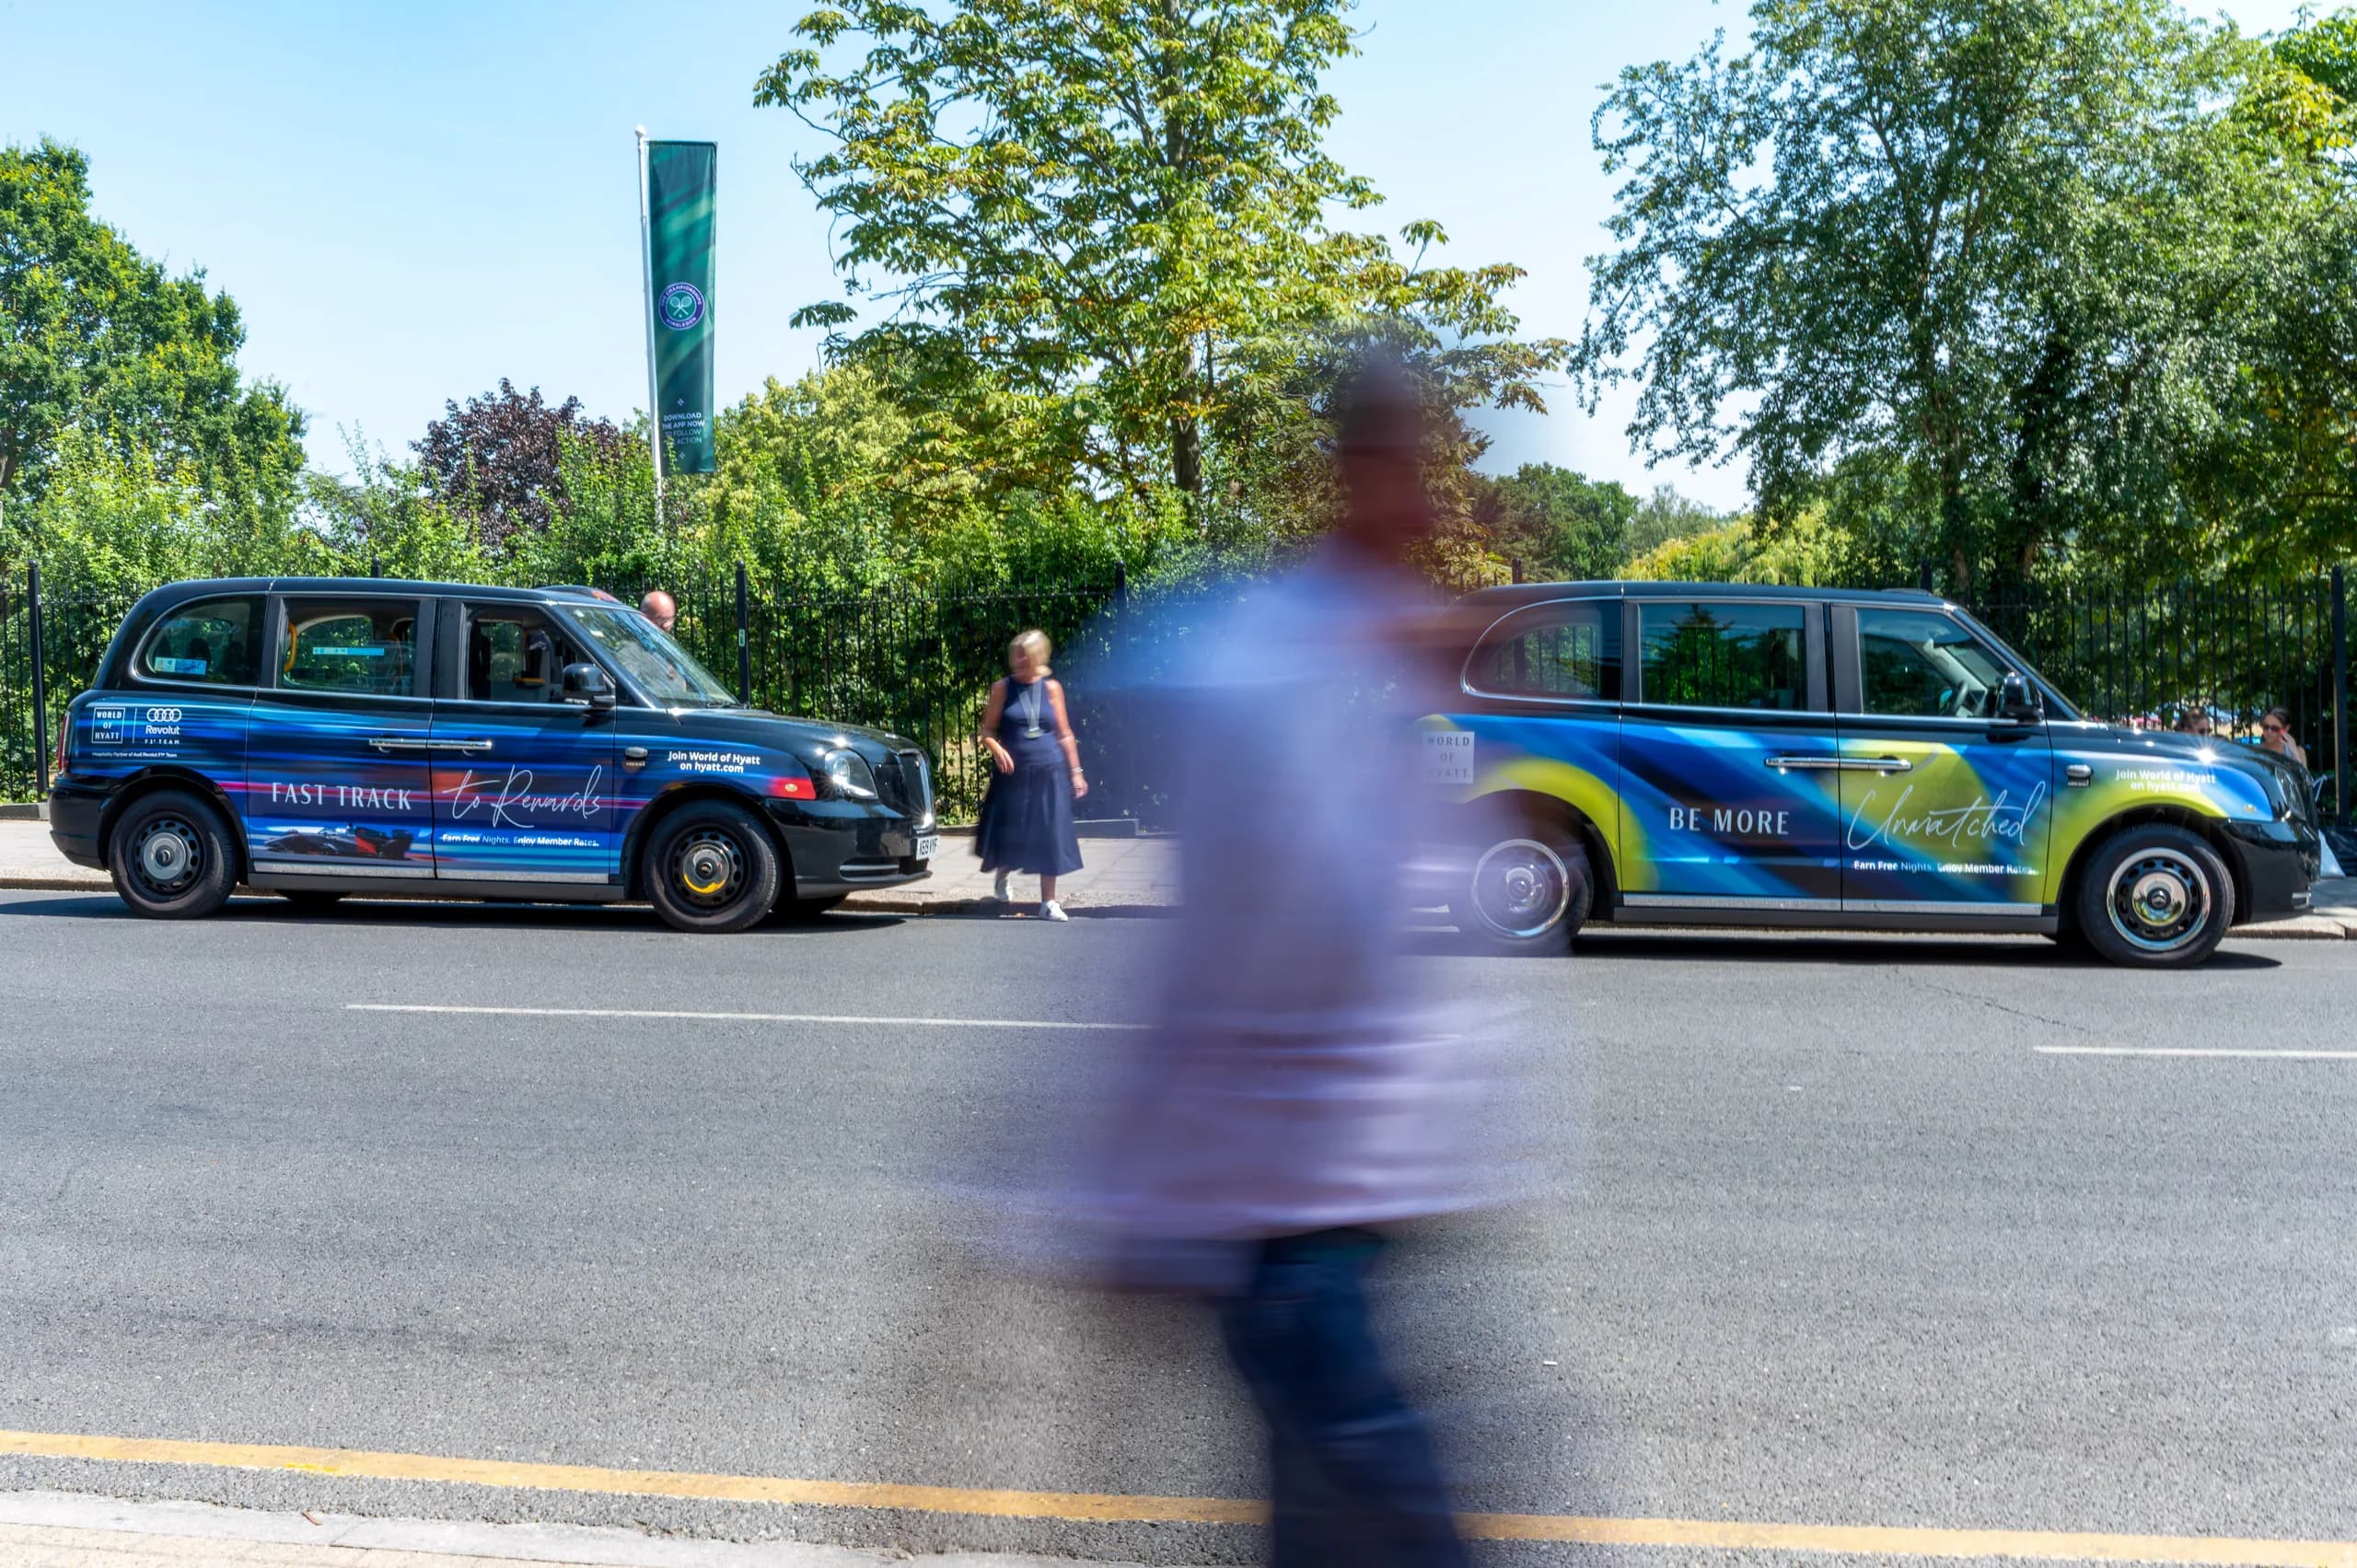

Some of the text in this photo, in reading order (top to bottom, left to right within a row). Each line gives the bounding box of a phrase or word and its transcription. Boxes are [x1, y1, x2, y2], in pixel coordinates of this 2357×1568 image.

[664, 412, 702, 421] DOWNLOAD
[673, 421, 686, 429] APP
[687, 420, 705, 428] NOW
[673, 428, 701, 436] FOLLOW
[97, 711, 122, 719] WORLD
[145, 725, 180, 735] Revolut
[1427, 736, 1469, 747] WORLD
[668, 751, 761, 765] Join World of Hyatt
[1439, 751, 1456, 762] OF
[679, 761, 744, 773] on hyatt.com
[2116, 769, 2216, 784] Join World of Hyatt
[2131, 782, 2144, 790] on
[272, 782, 412, 810] FAST TRACK
[442, 764, 602, 828] to Rewards
[1670, 807, 1789, 835] BE MORE
[482, 835, 510, 845] Nights.
[513, 836, 536, 845] Enjoy
[537, 837, 573, 846] Member
[1853, 861, 1875, 870] Earn
[1877, 861, 1898, 870] Free
[1900, 862, 1933, 874] Nights.
[1965, 864, 2003, 874] Member
